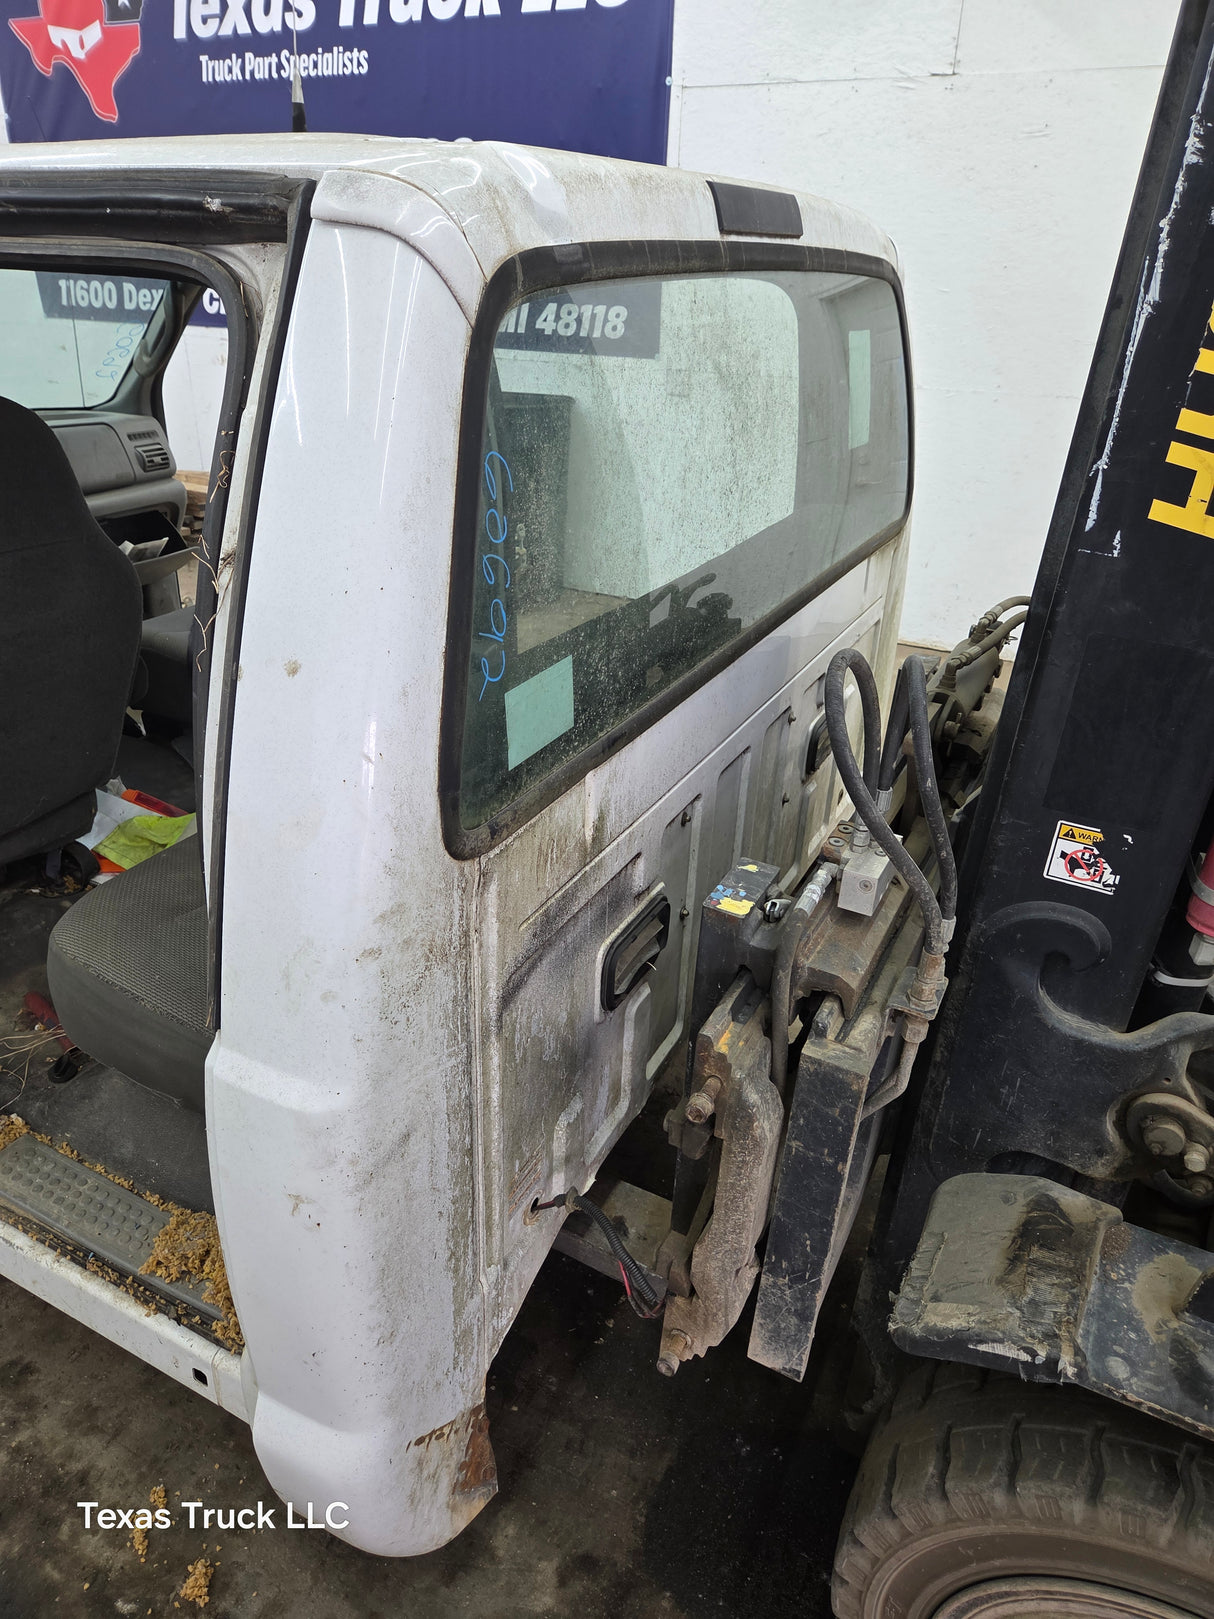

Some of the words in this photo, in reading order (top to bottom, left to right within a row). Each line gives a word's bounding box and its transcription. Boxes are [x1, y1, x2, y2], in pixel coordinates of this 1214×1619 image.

[200, 53, 243, 82] Truck
[244, 52, 279, 81] Part
[280, 46, 369, 81] Specialists
[58, 278, 118, 310] 11600
[535, 302, 629, 340] 48118
